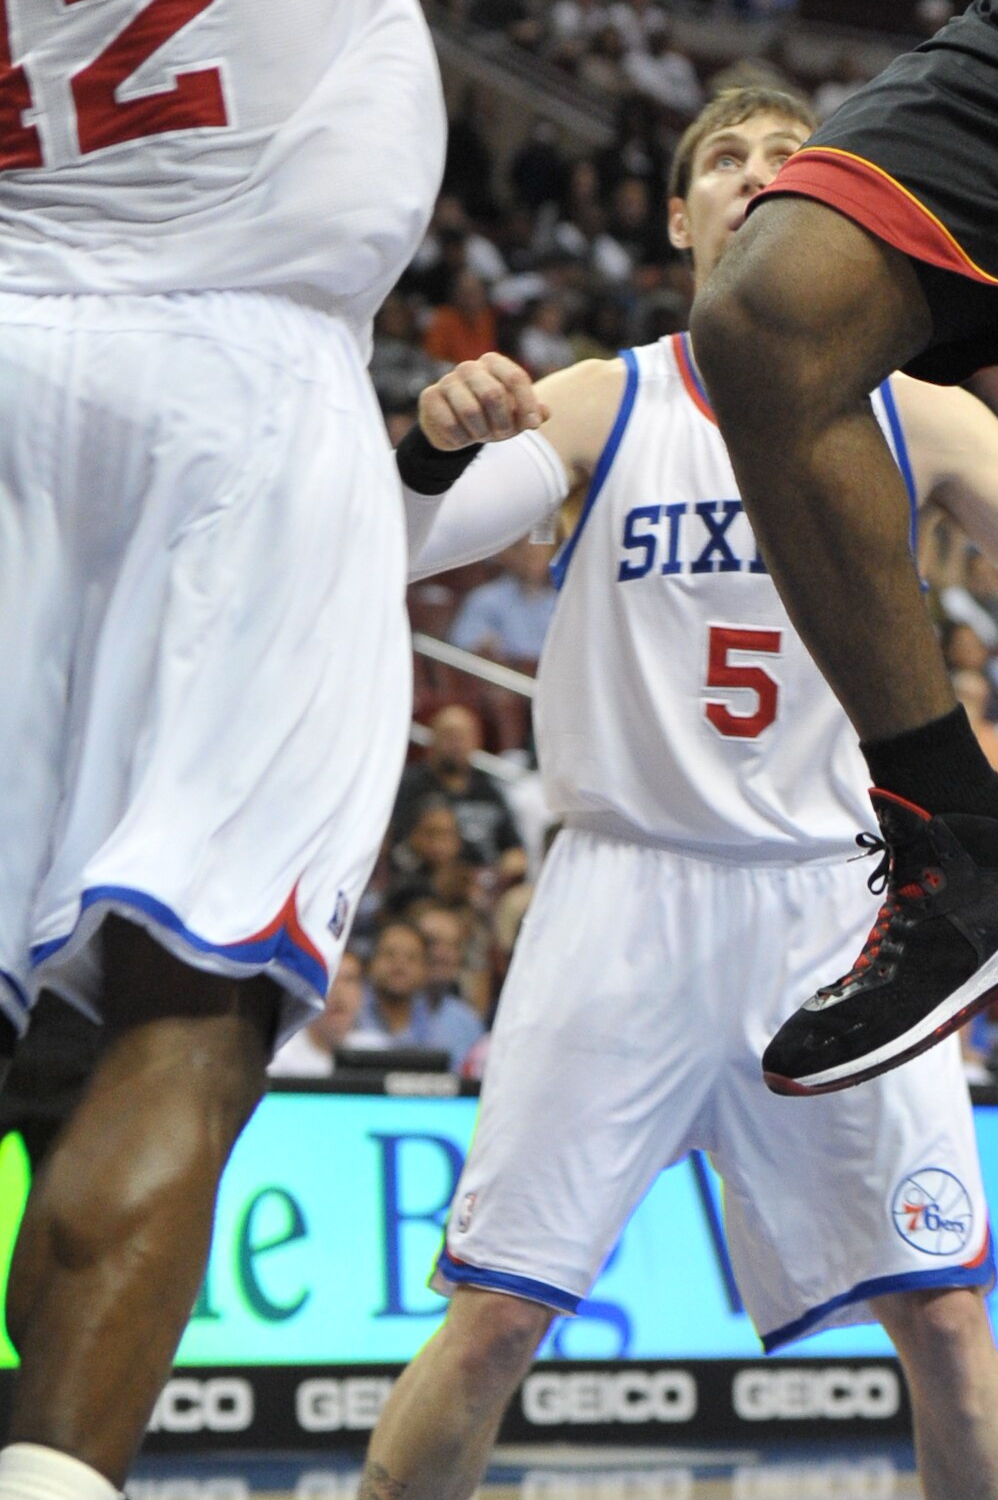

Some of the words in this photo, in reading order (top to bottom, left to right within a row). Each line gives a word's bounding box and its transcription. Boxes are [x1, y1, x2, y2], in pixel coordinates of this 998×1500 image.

[617, 500, 772, 582] SIX
[705, 626, 782, 739] 5
[521, 1370, 697, 1425] GEICO
[732, 1368, 899, 1420] GEICO
